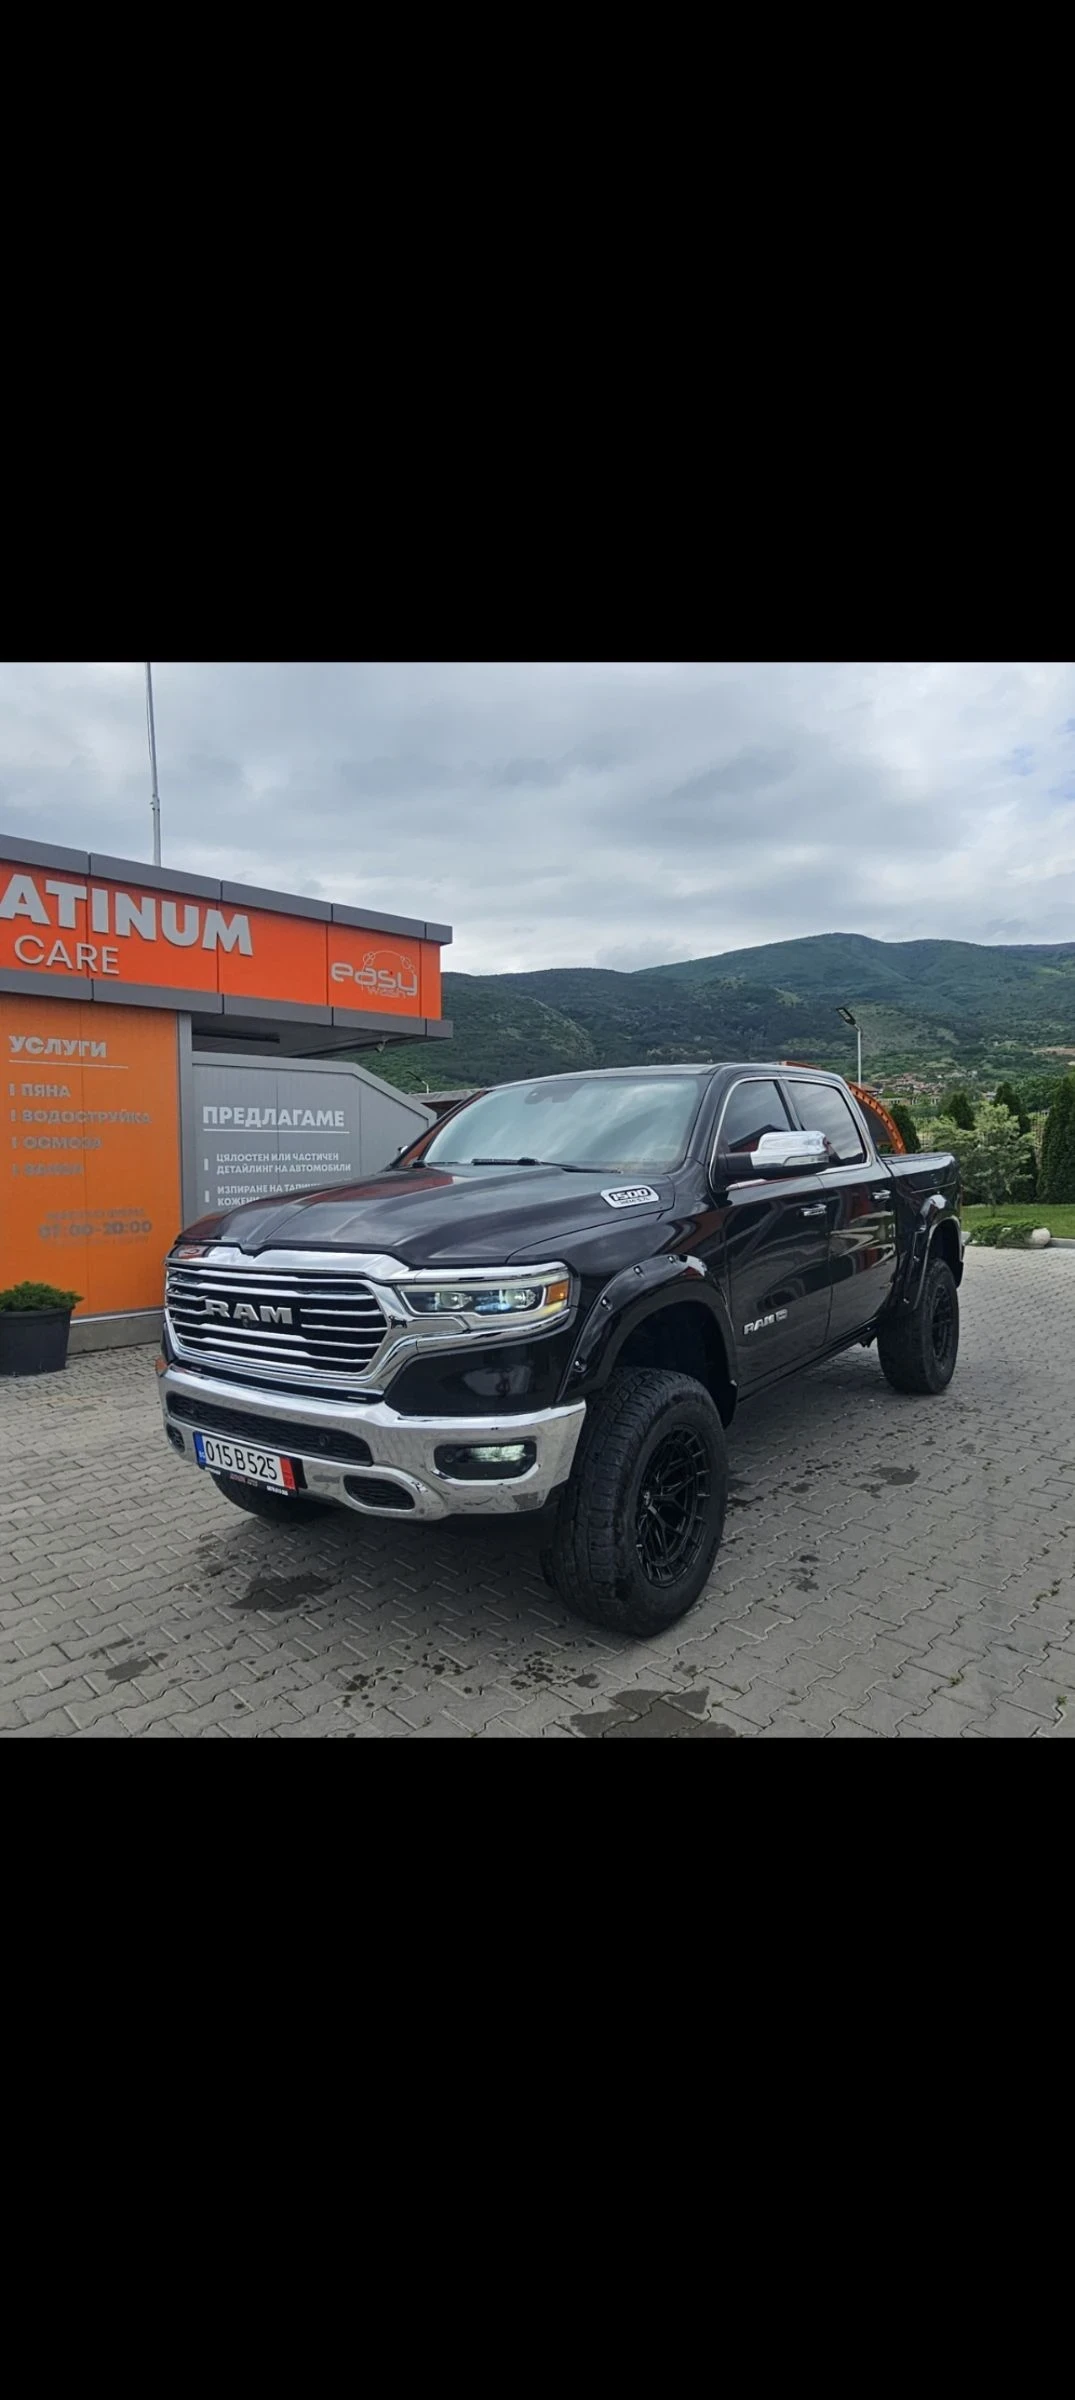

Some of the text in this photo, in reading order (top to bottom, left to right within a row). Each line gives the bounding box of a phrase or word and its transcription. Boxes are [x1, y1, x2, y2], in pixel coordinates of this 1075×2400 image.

[14, 935, 120, 975] CARE
[331, 962, 418, 997] easy
[8, 1035, 108, 1058] УСЛУГИ
[21, 1083, 71, 1098] ПЯНА
[22, 1108, 153, 1125] ВОДОСТРУЙКА
[202, 1106, 345, 1128] ПРЕДЛАГАМЕ
[216, 1152, 339, 1163] ЦЯЛОСТЕН ИЛИ ЧАСТИЧЕН
[216, 1163, 351, 1175] ДЕТАЙЛИНГ НА АВТОМОБИЛИ
[217, 1184, 268, 1195] ИЗПИРАНЕ
[269, 1183, 283, 1193] НА
[610, 1188, 649, 1201] 1500
[204, 1299, 293, 1325] RAM
[743, 1314, 775, 1335] RAM
